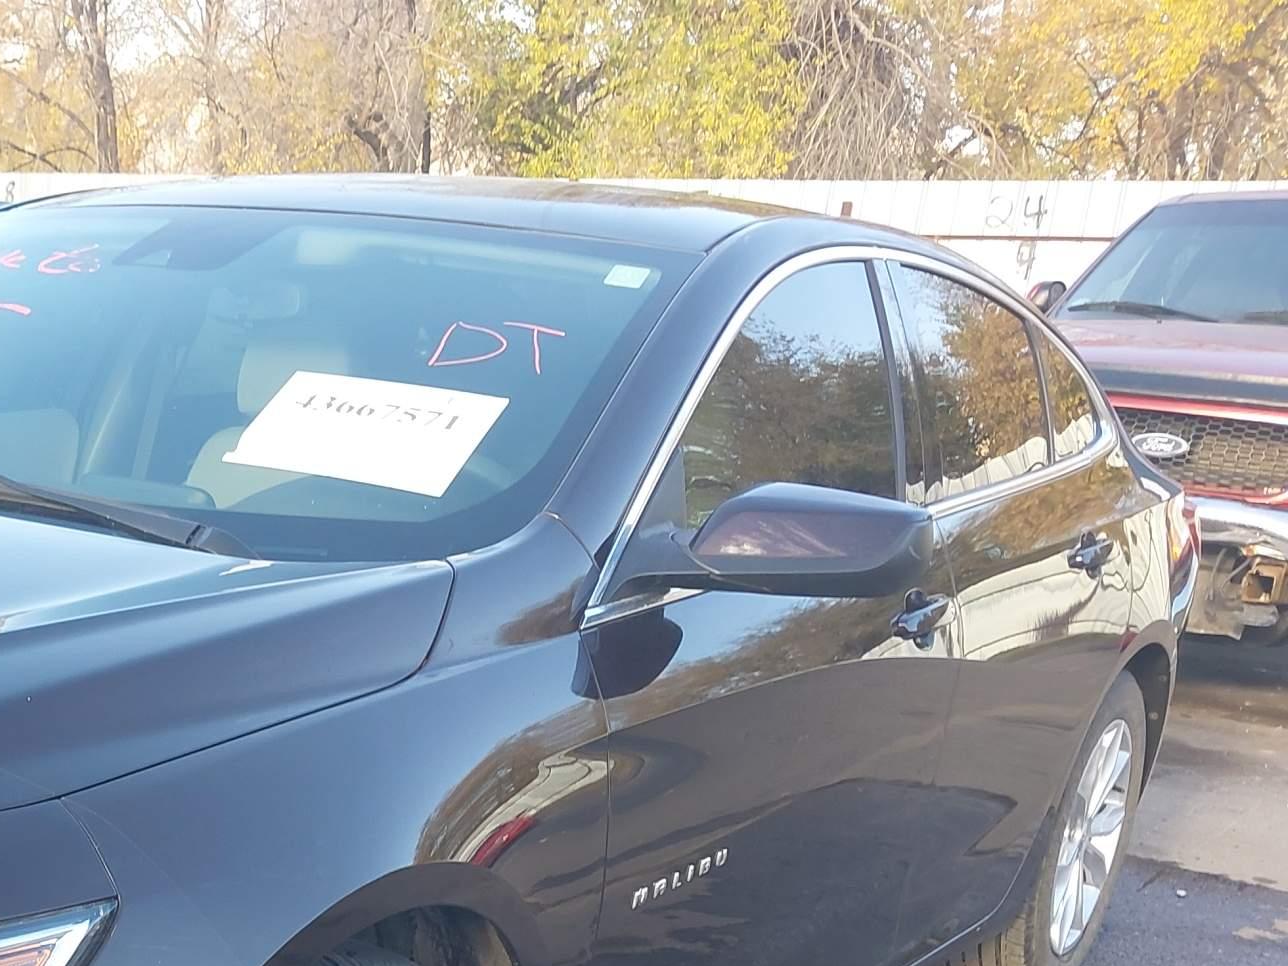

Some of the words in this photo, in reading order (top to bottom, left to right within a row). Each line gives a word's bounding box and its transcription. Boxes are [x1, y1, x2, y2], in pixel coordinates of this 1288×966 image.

[427, 320, 566, 376] DT
[295, 393, 461, 431] 43667571
[632, 847, 729, 910] MALIBU
